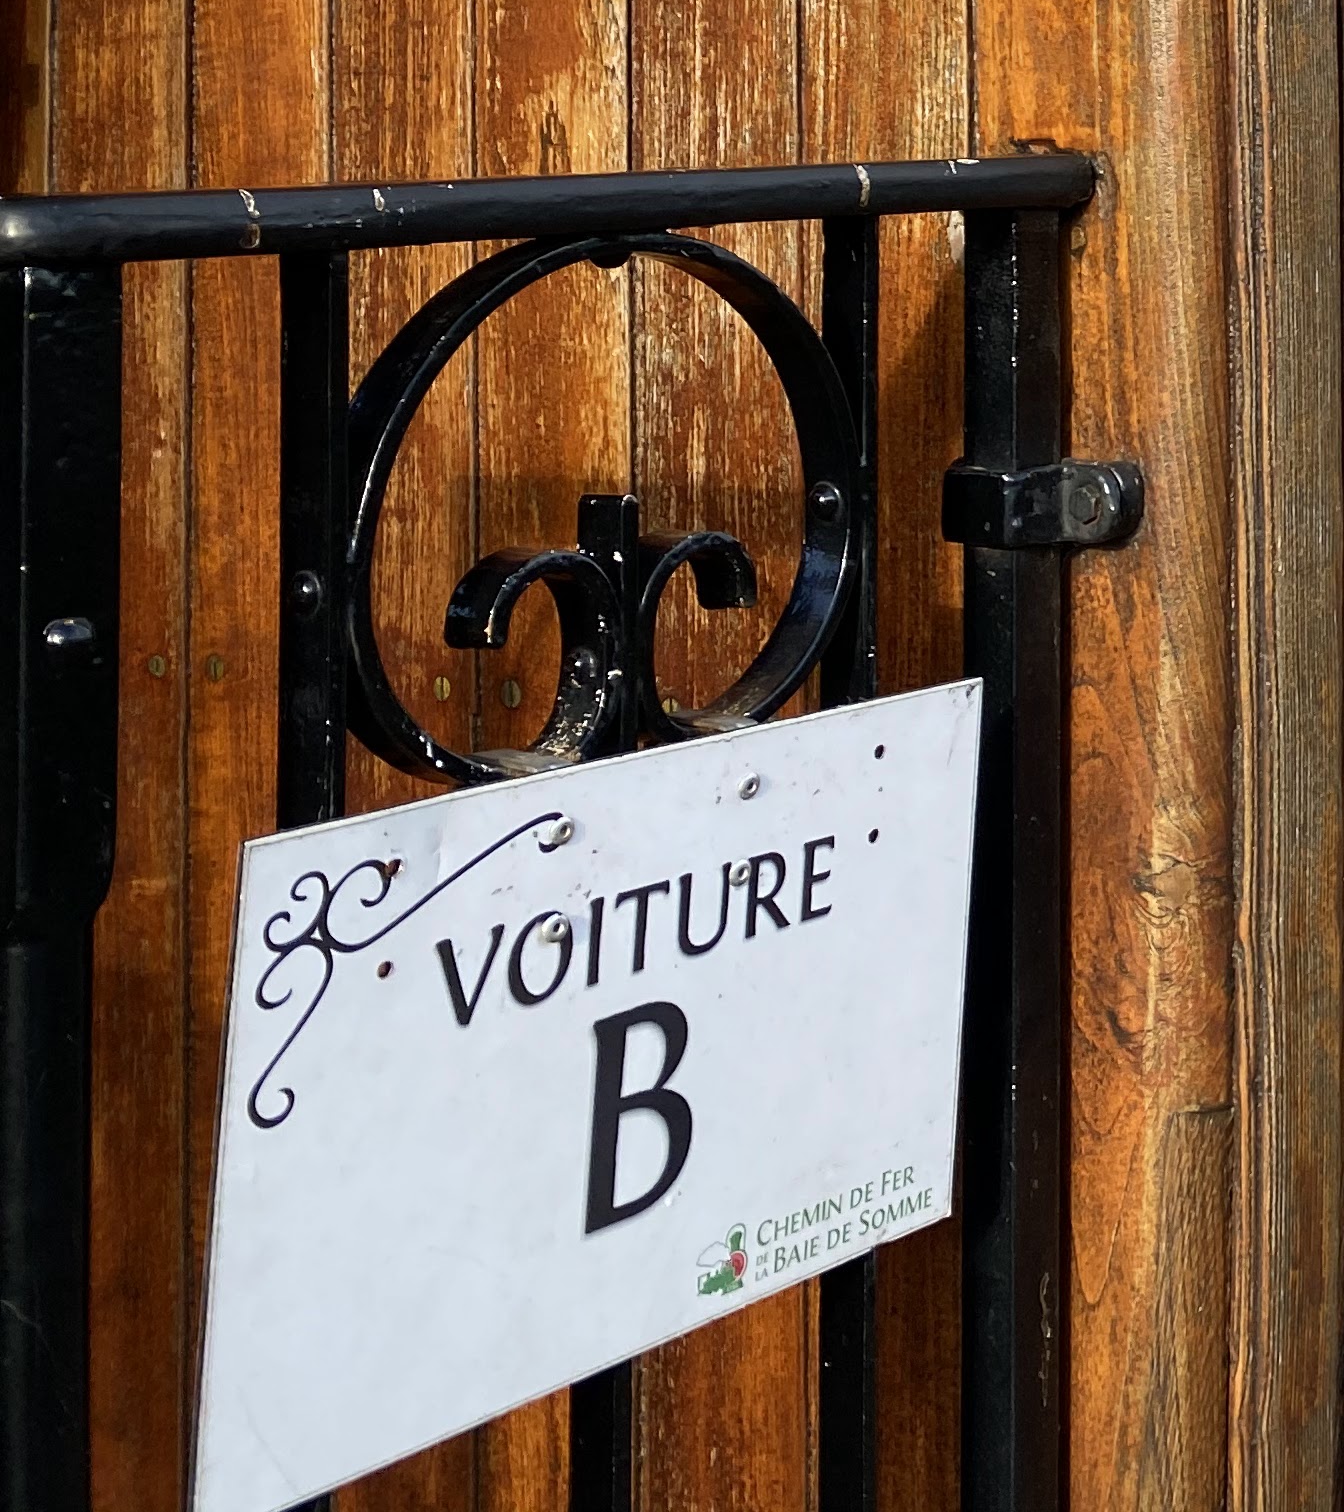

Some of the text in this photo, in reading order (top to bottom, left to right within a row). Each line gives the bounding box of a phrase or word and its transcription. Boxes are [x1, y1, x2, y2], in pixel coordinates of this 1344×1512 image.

[436, 835, 835, 1026] VOITURE
[585, 1001, 692, 1235] B
[757, 1166, 914, 1247] CHEMIN DE FER
[773, 1188, 933, 1273] BAIE DE SOMME
